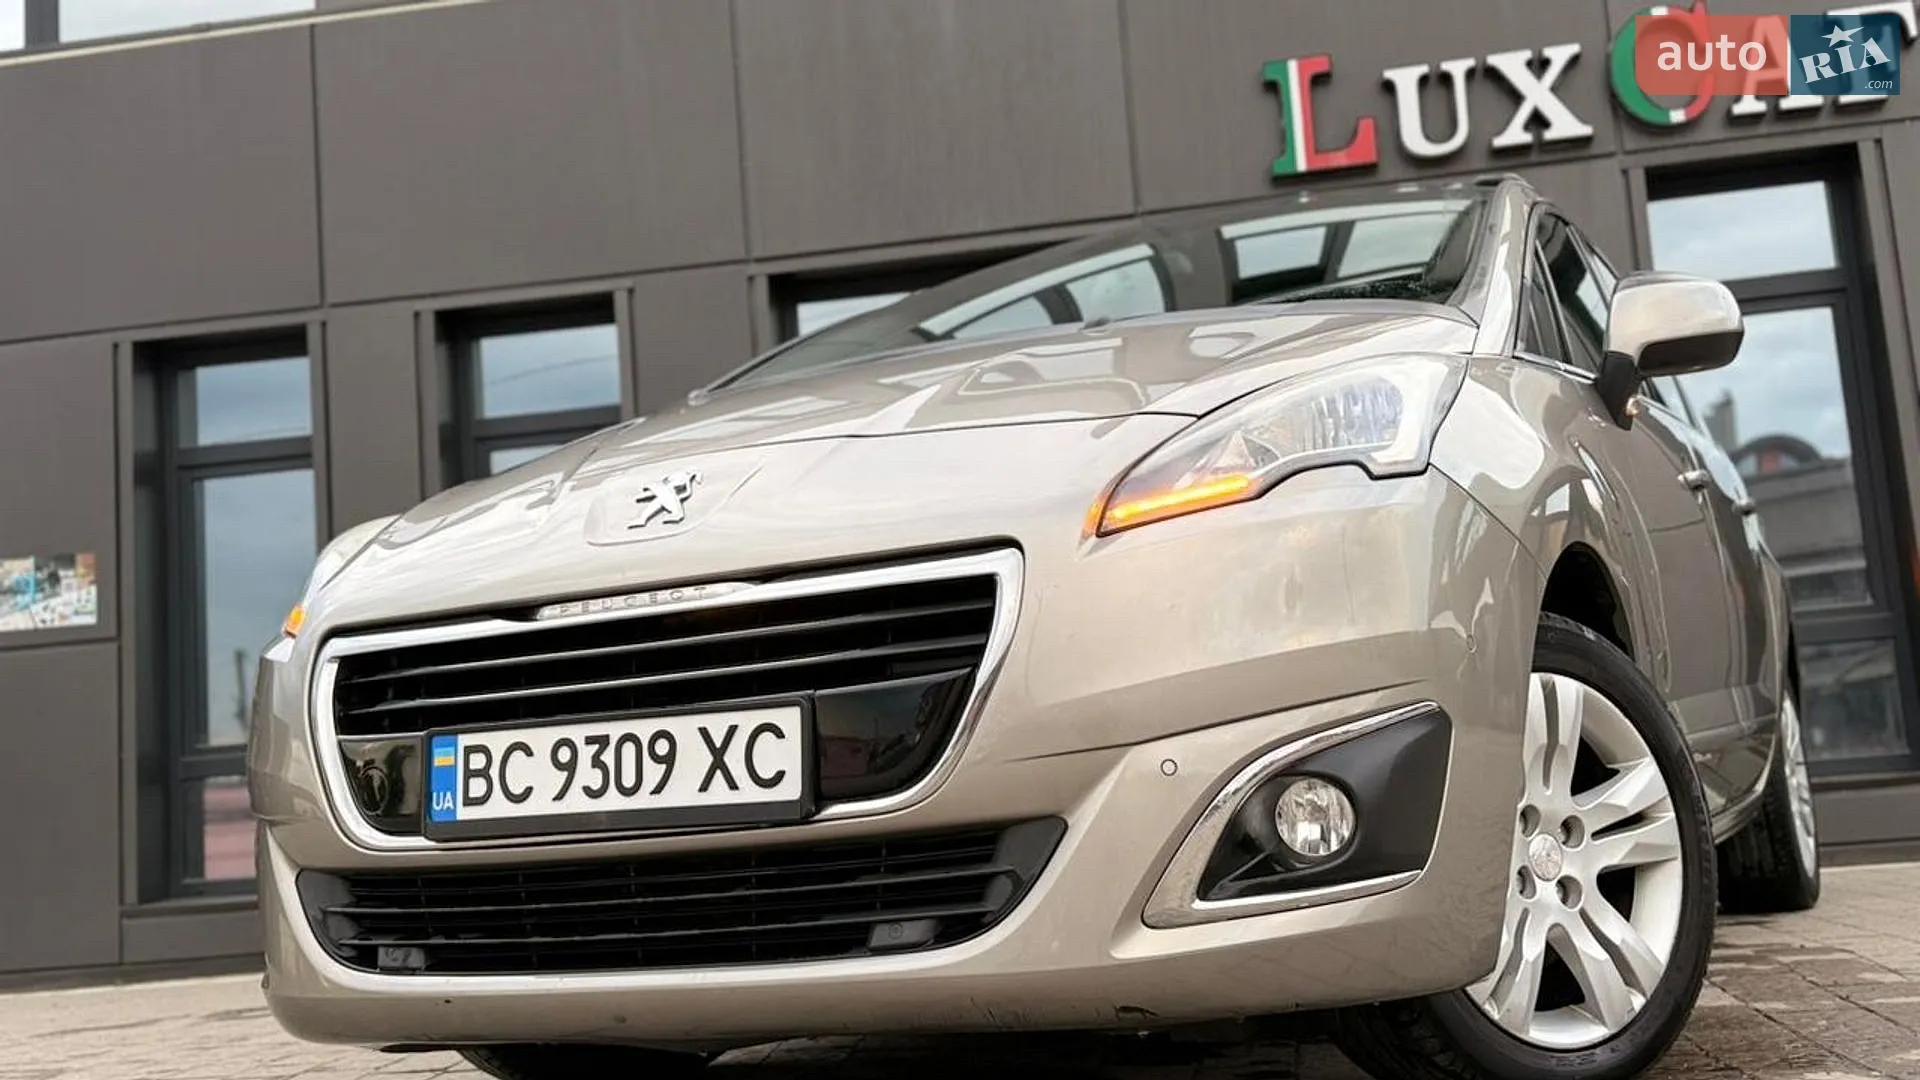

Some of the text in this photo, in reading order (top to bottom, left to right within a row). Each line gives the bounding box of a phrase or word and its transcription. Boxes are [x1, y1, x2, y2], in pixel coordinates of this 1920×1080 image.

[1262, 43, 1594, 175] LUX
[559, 586, 707, 614] PEUGEOT
[461, 721, 787, 807] BC 9309 XC
[432, 791, 456, 811] UA
